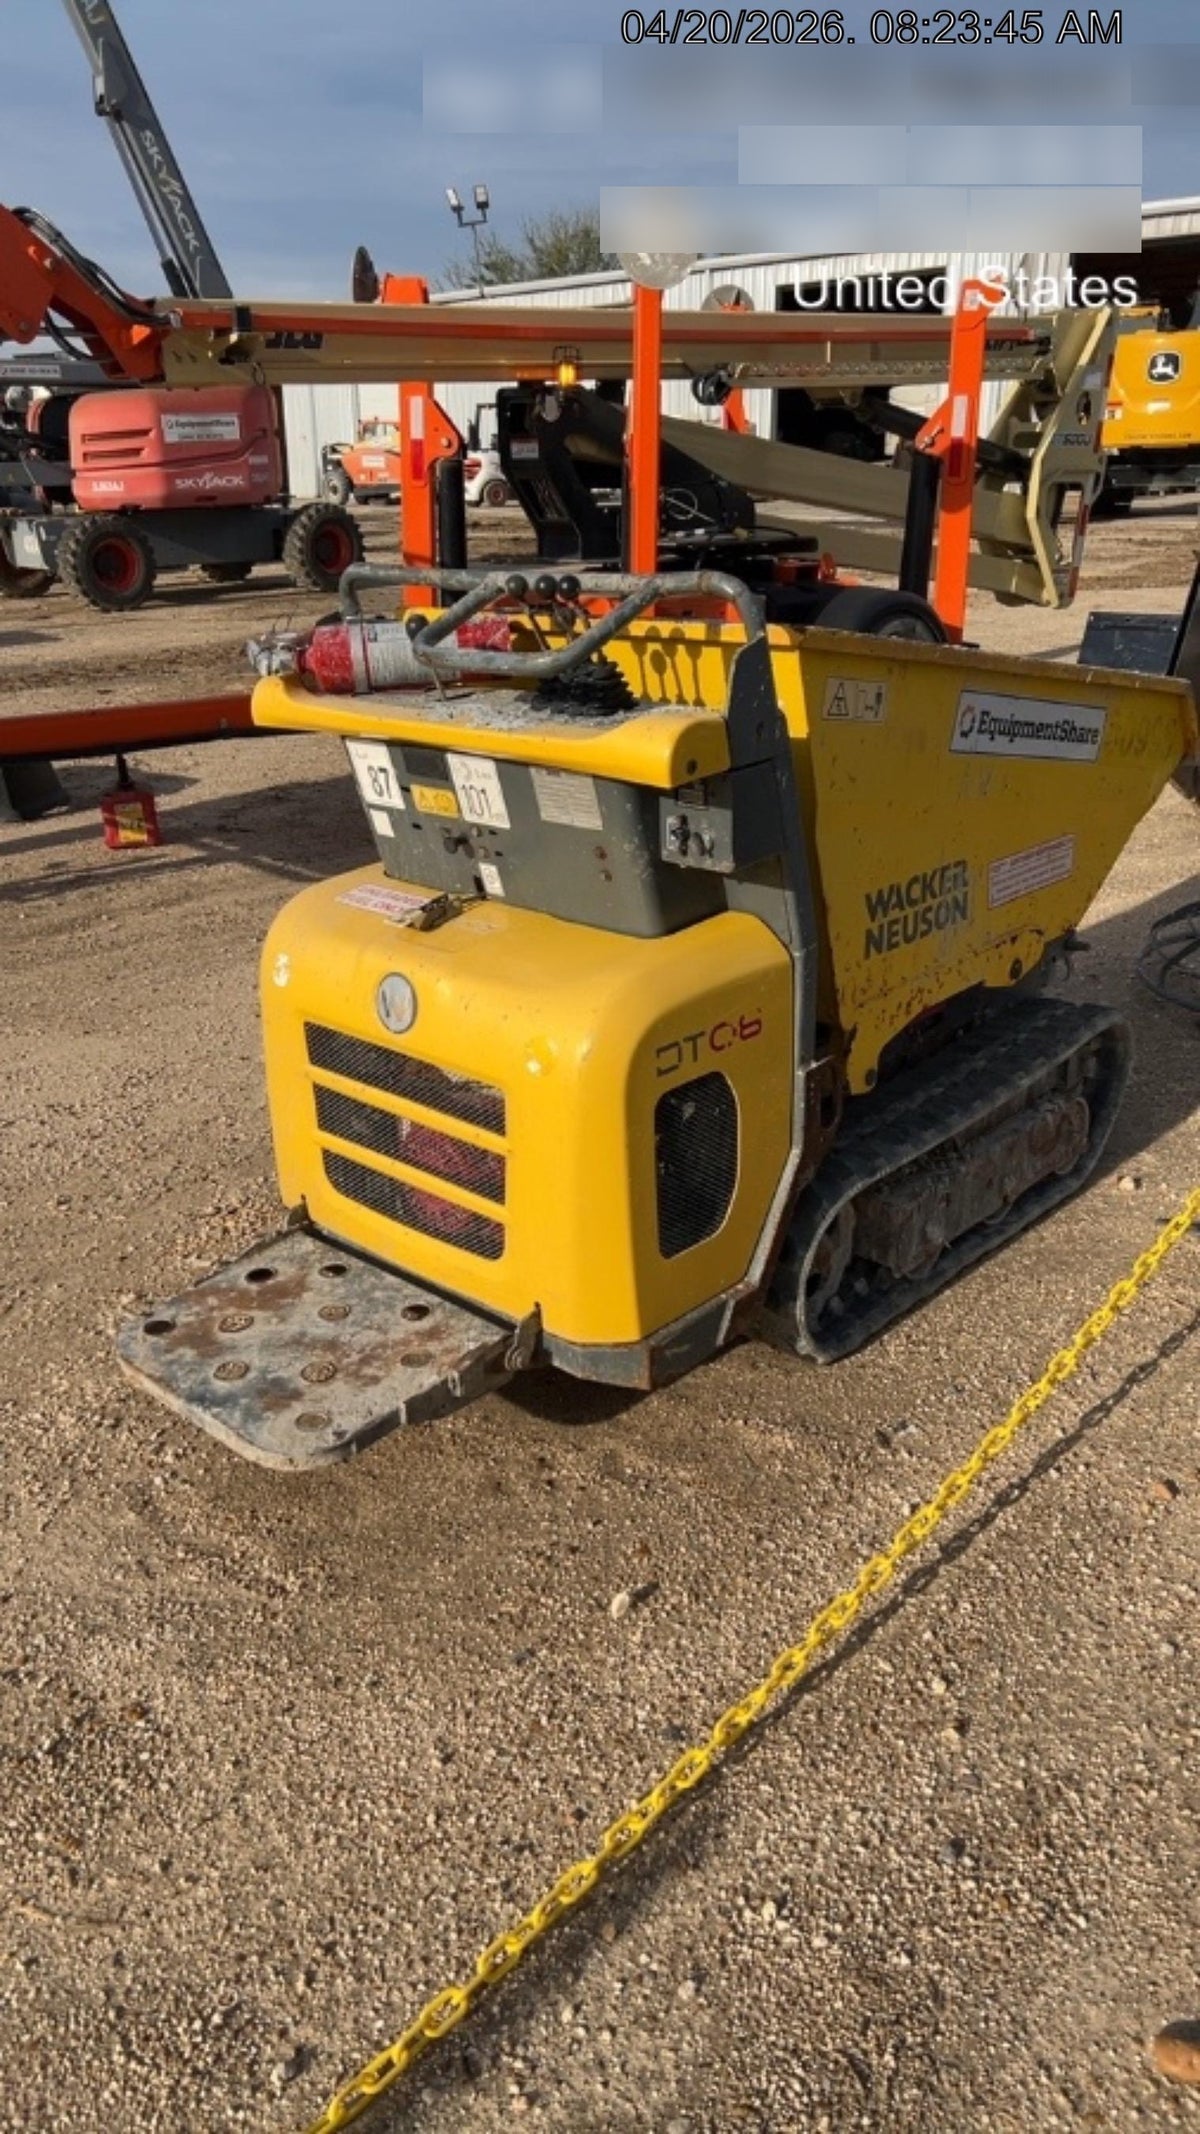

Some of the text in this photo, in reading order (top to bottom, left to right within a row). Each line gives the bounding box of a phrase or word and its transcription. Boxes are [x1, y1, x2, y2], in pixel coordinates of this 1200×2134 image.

[139, 129, 201, 252] SKYJACK
[174, 472, 245, 490] SKYJACK
[976, 710, 1100, 744] EquipmentShare
[367, 765, 392, 800] 87
[461, 784, 492, 818] 101
[864, 859, 968, 923] WACKER
[863, 890, 969, 961] NEUSON
